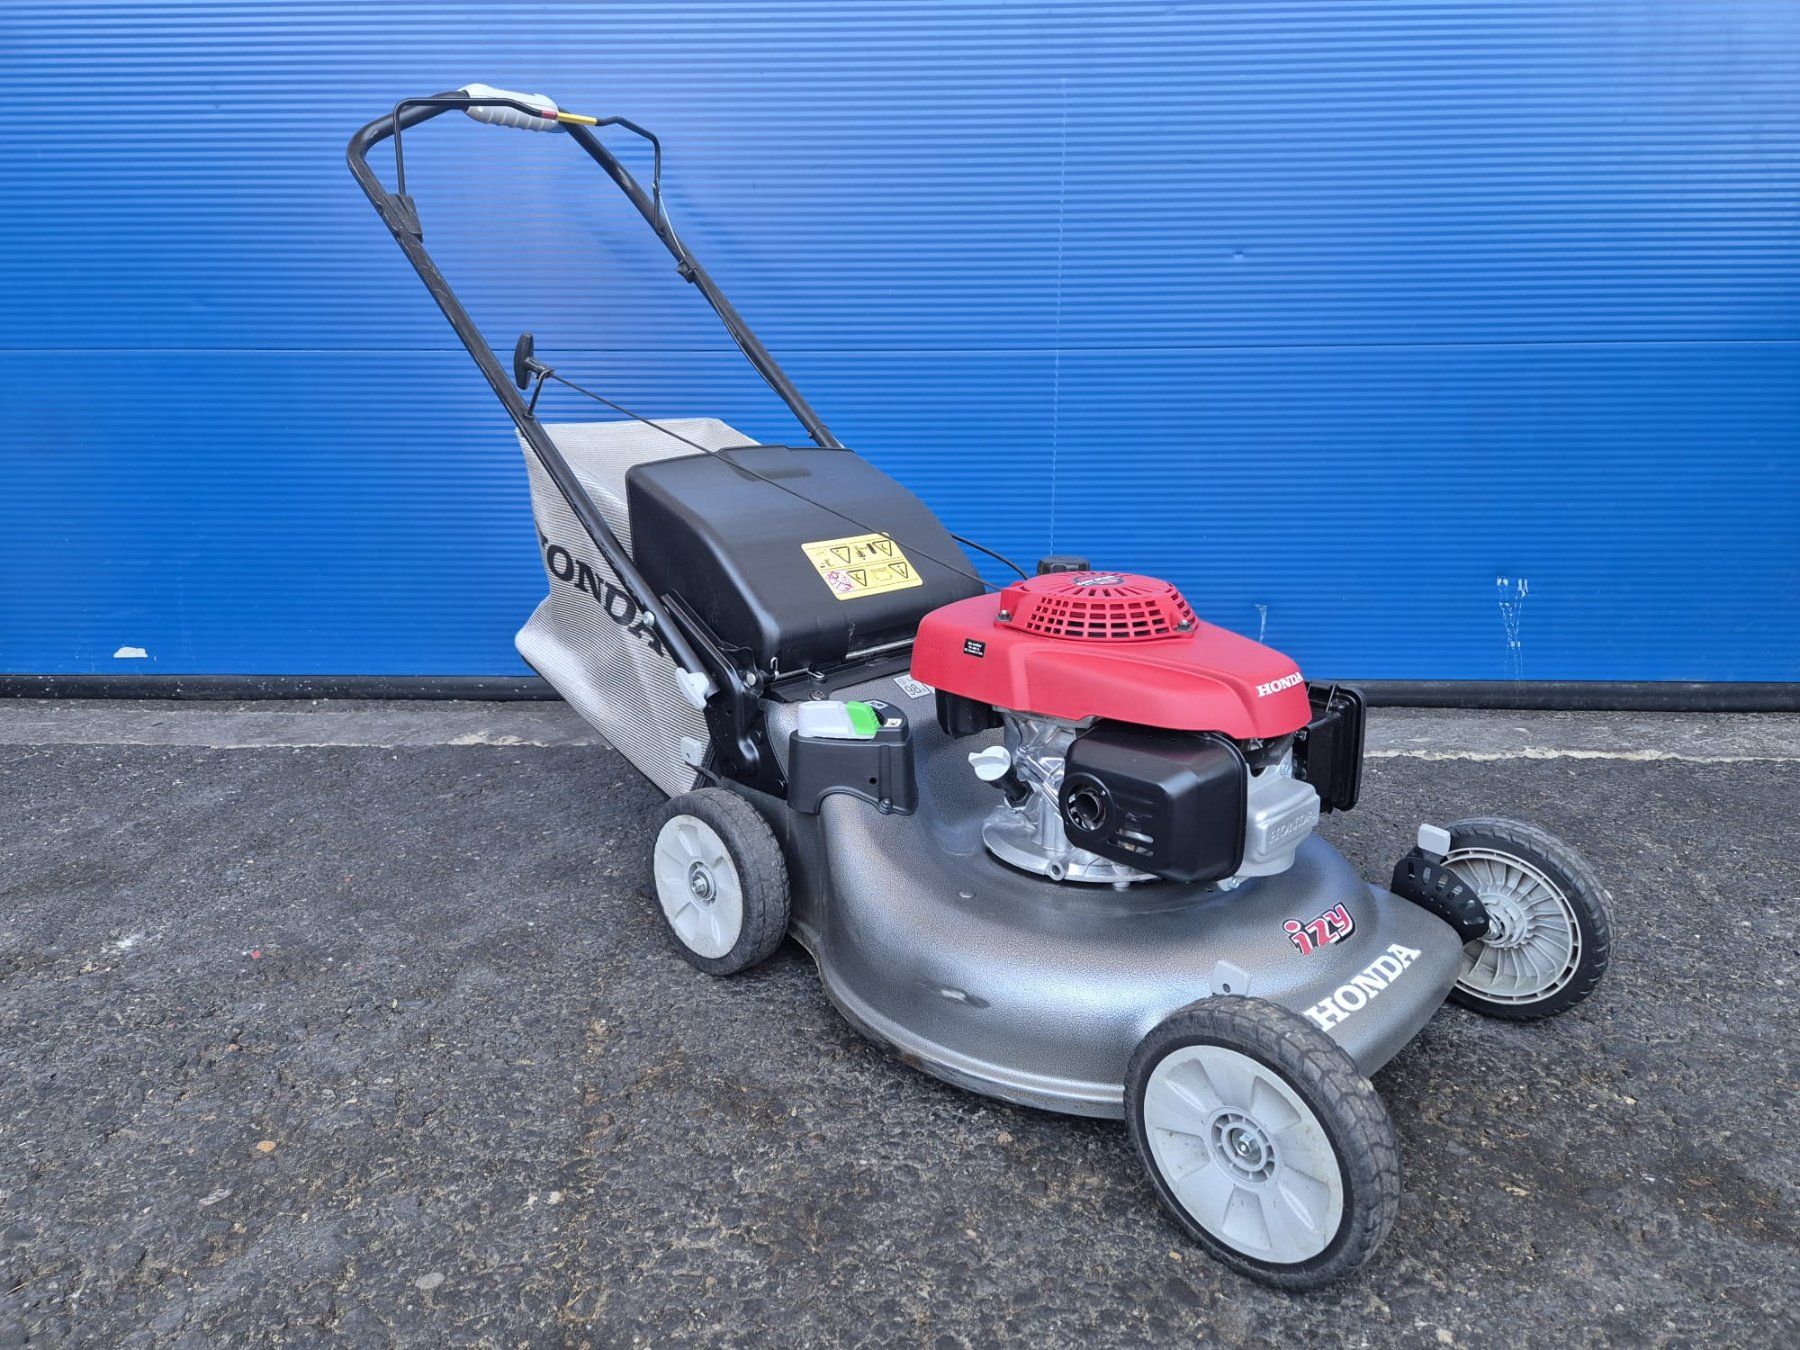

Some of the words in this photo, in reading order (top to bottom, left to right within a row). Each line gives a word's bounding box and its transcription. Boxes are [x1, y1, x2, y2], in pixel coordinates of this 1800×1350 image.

[904, 684, 921, 695] 98
[1255, 671, 1303, 697] HONDA
[1283, 901, 1356, 956] izy
[1301, 943, 1421, 1032] HONDA
